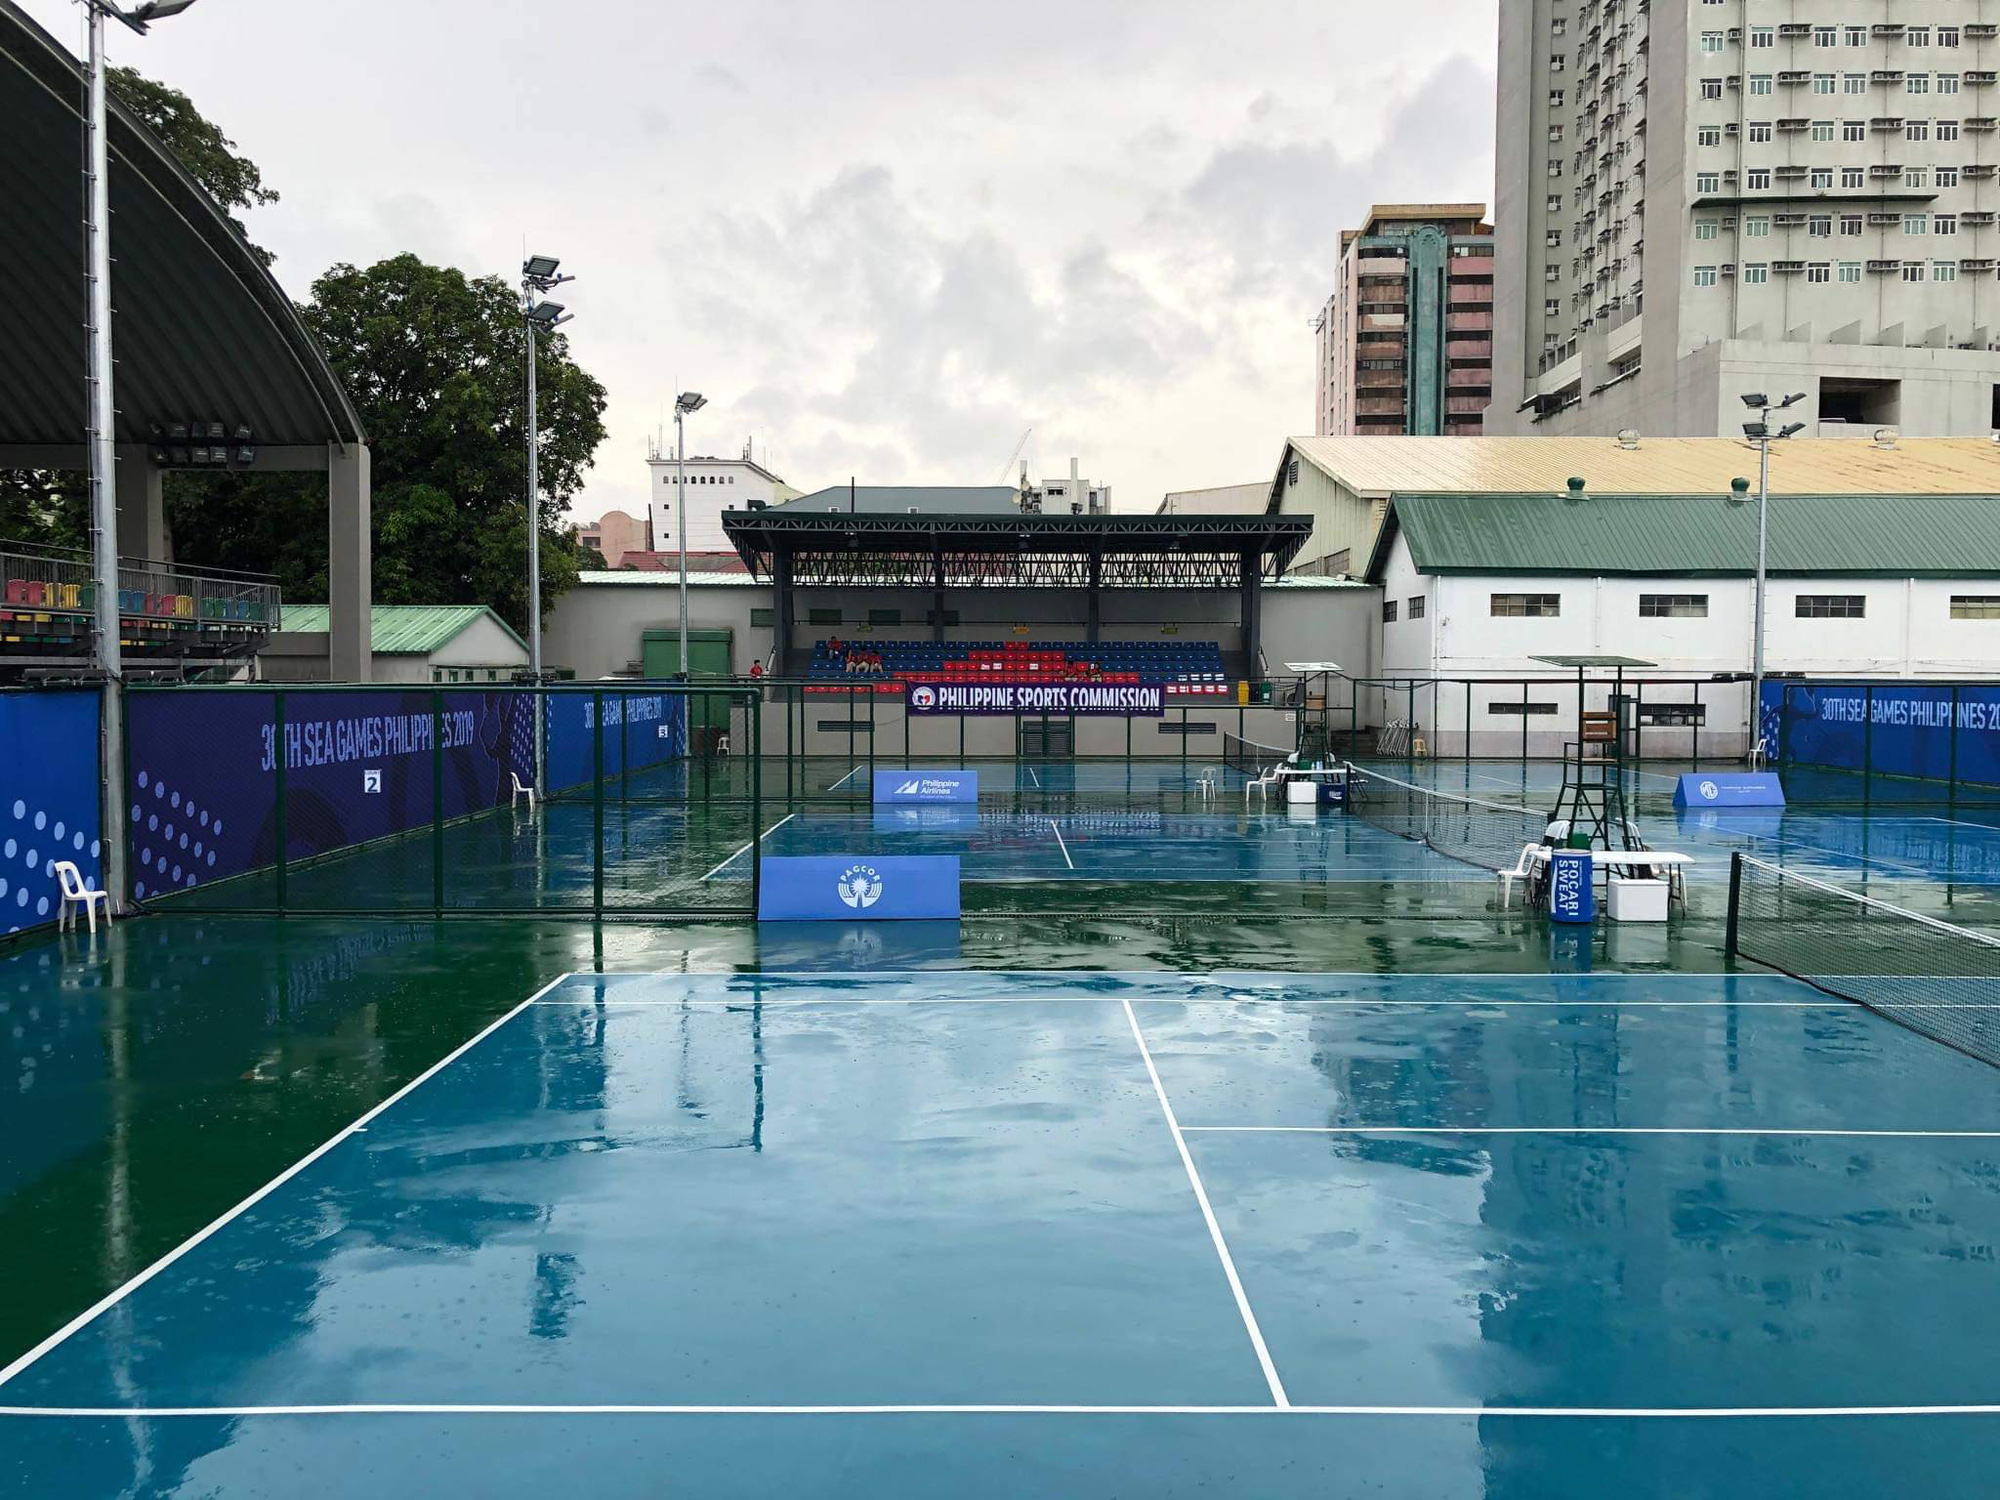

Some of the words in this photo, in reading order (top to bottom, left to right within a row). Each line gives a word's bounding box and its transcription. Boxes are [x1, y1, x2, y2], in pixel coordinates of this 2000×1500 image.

[939, 687, 1014, 710] PHILIPPINE
[1017, 687, 1066, 711] SPORTS
[1071, 687, 1160, 711] COMMISSION
[1822, 698, 1846, 721] 30TH
[1848, 698, 1868, 722] SEA
[1871, 699, 1908, 725] GAMES
[304, 720, 335, 767] SEA
[337, 717, 381, 762] GAMES
[385, 712, 452, 755] PHILIPPIS
[453, 710, 474, 746] 2019
[367, 776, 378, 791] 2
[922, 780, 960, 788] Philippine
[840, 865, 881, 881] PAGCOR
[1559, 859, 1569, 911] SWEAT
[1568, 860, 1578, 916] POCARI
